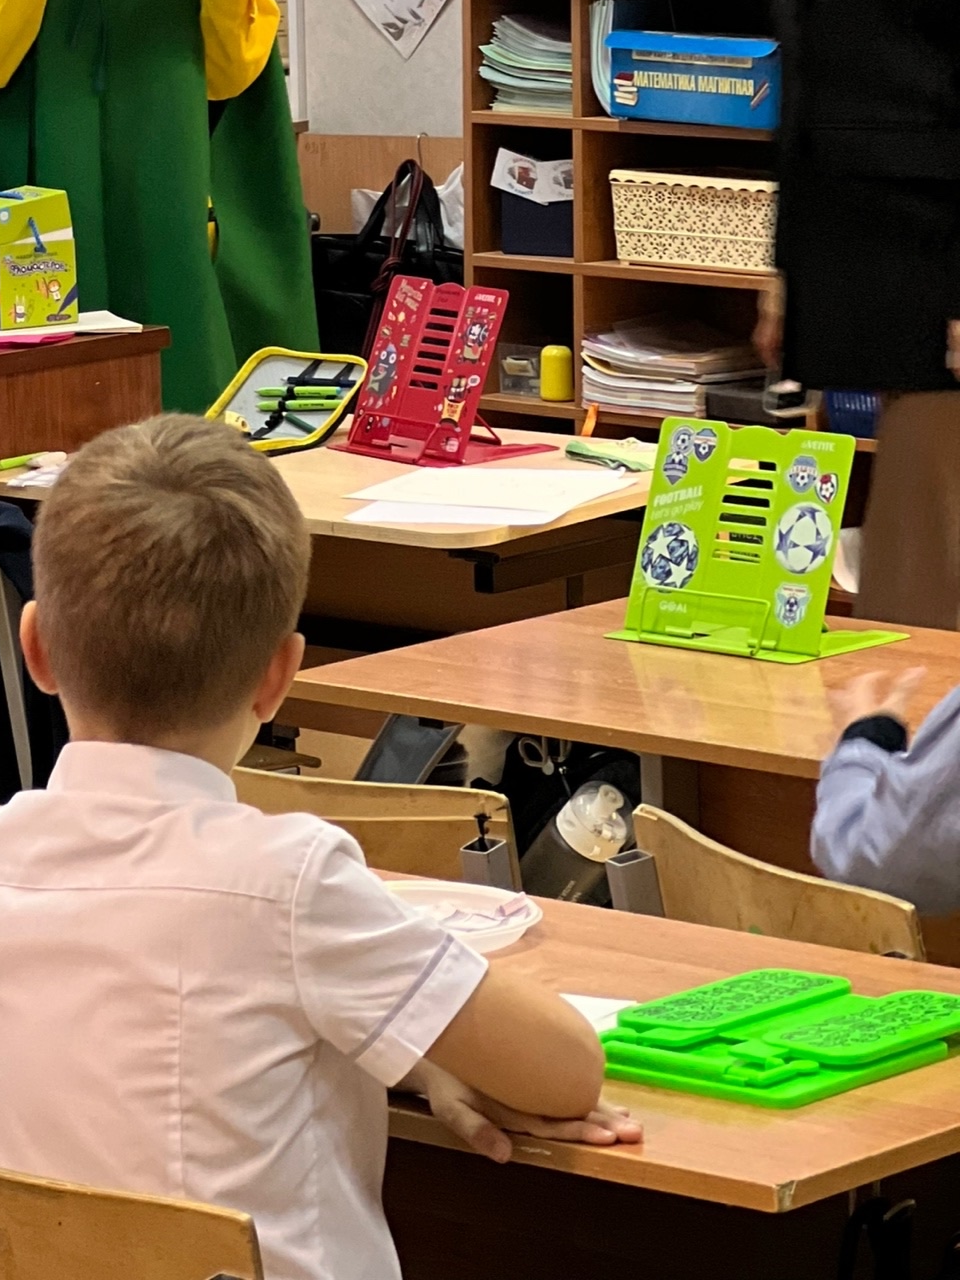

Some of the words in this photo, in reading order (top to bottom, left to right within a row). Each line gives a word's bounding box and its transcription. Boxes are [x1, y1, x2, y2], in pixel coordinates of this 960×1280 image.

[634, 71, 696, 92] МАТЕМАТИКА
[698, 75, 754, 96] МАГНИТНАЯ
[653, 485, 703, 507] FOOTBALL
